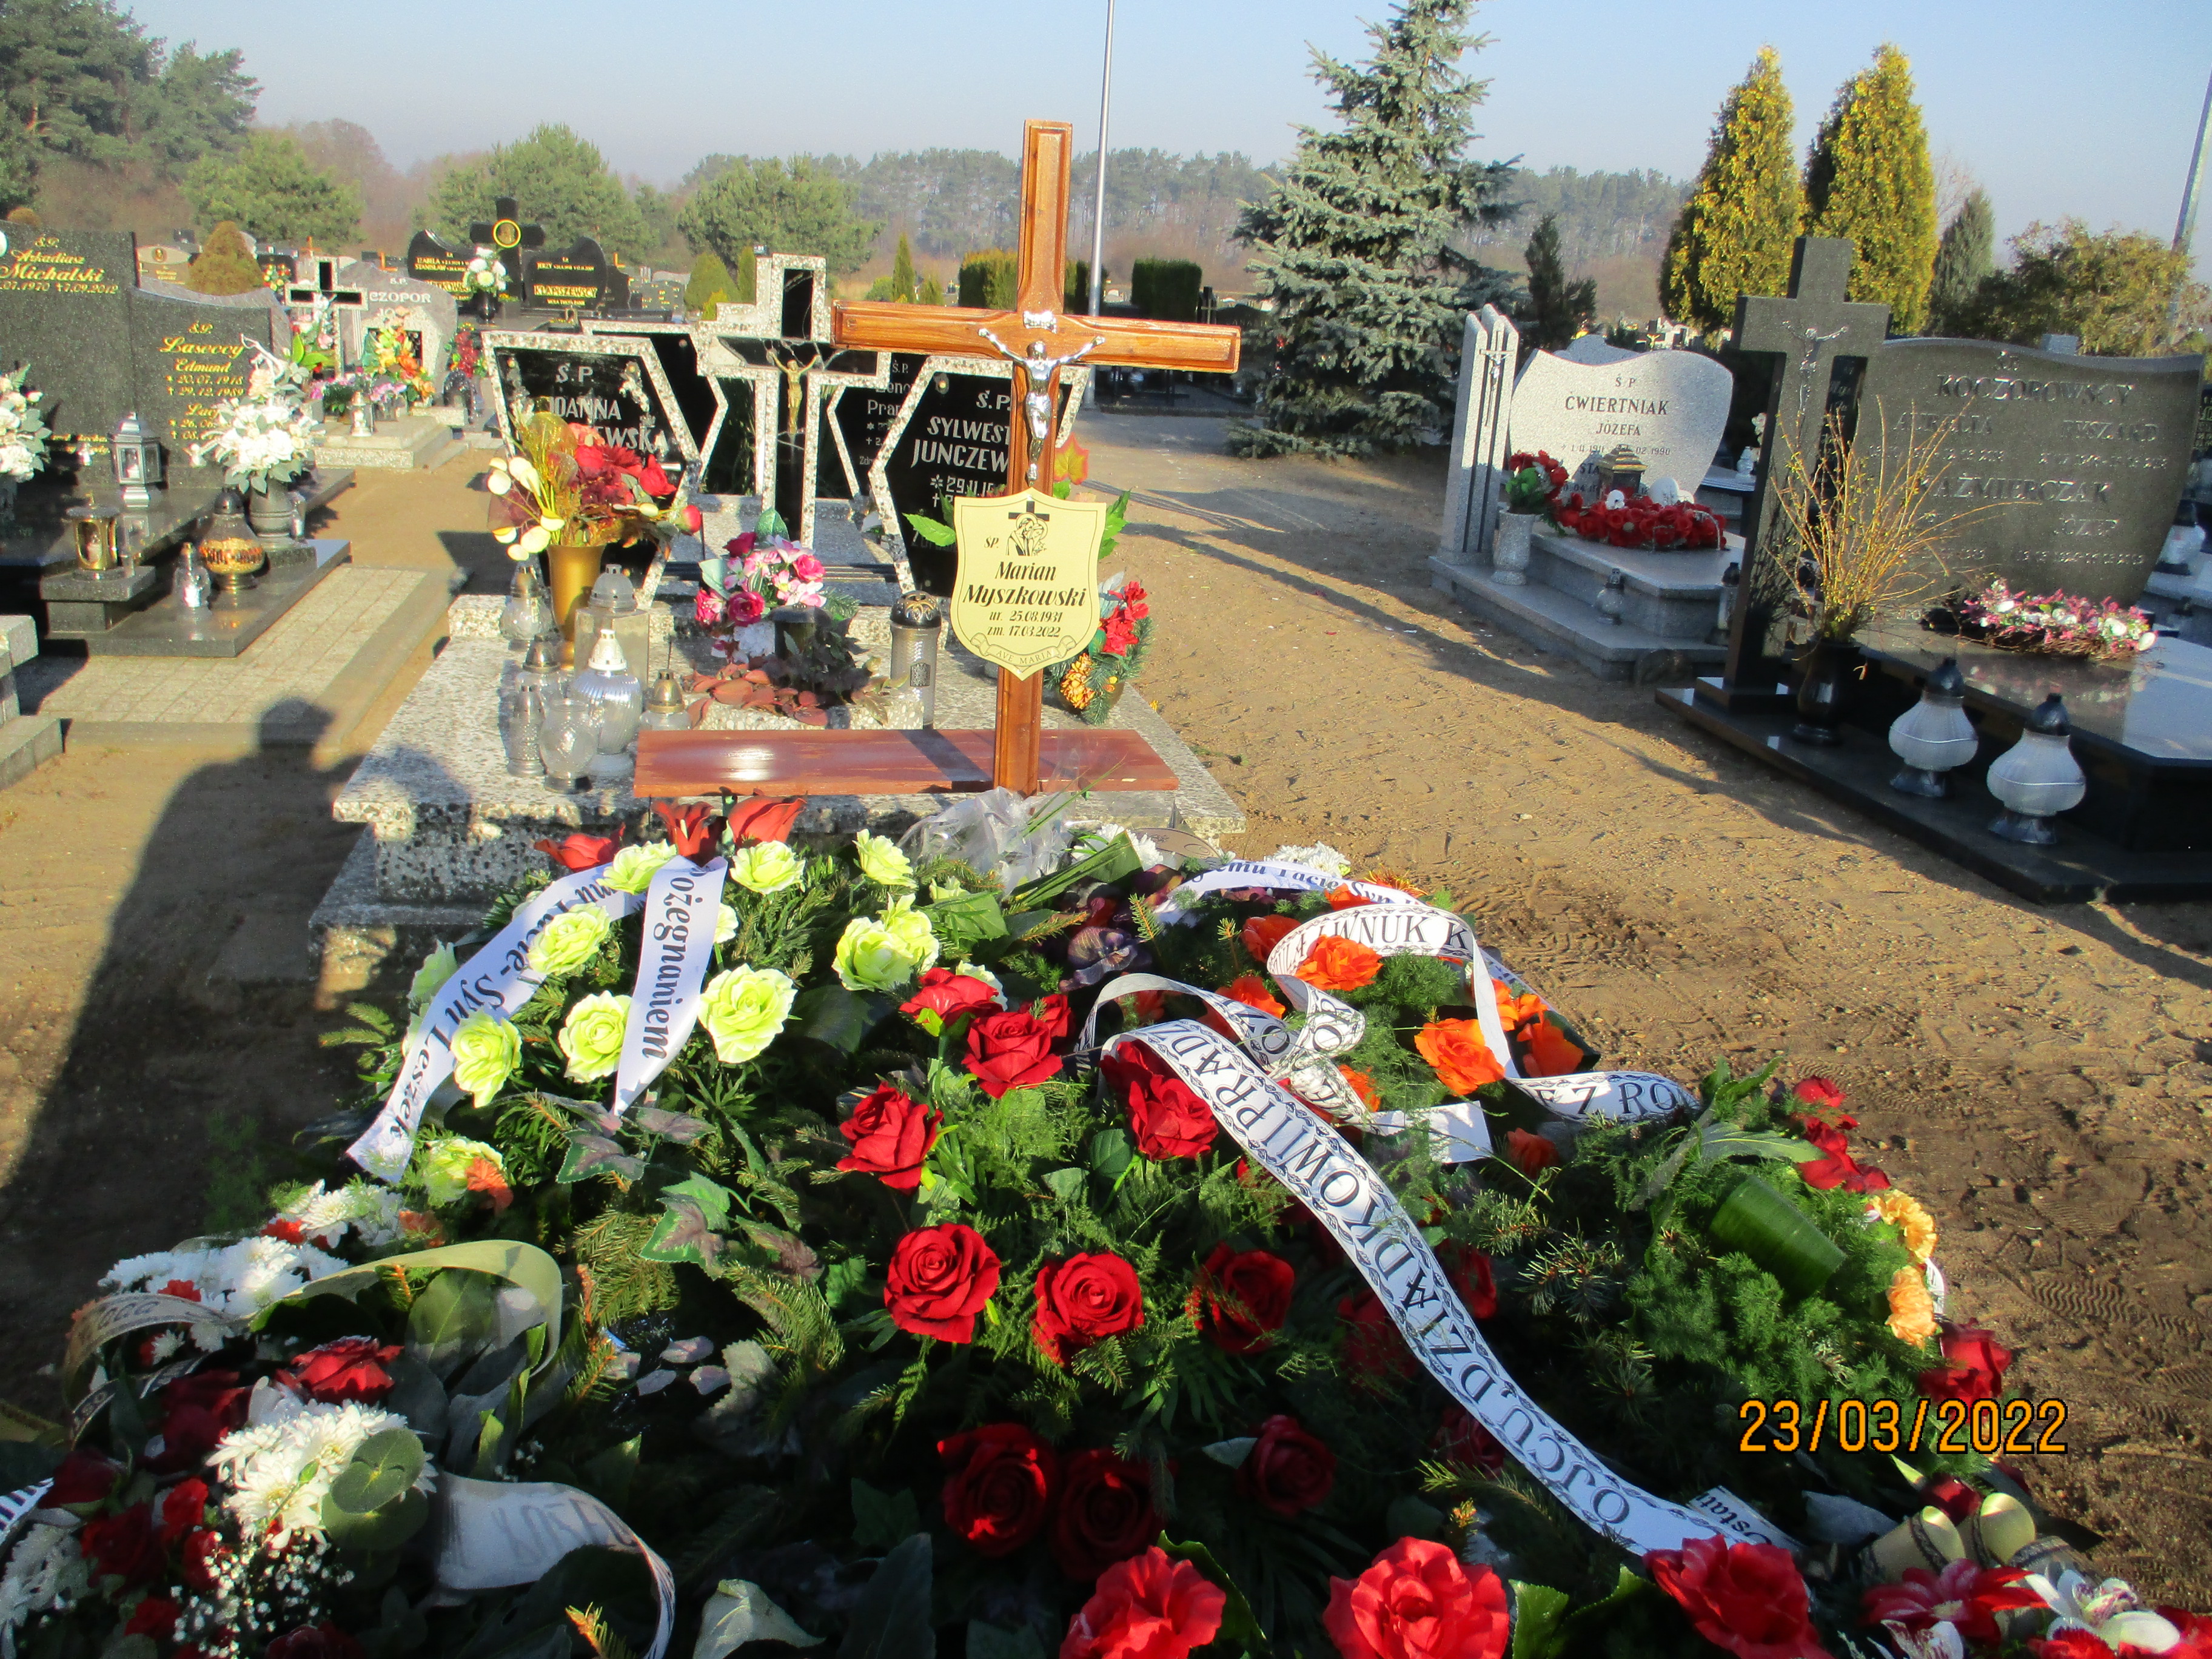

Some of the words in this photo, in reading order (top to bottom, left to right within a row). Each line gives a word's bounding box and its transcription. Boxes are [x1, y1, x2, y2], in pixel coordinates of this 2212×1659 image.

[0, 263, 105, 282] Michalski
[175, 358, 232, 373] Edmund
[994, 561, 1056, 581] Marian
[962, 584, 1087, 607] Myszkowski
[989, 612, 1003, 622] ur.
[1009, 610, 1063, 623] 25.08.1931
[987, 626, 1005, 636] zm.
[1009, 625, 1061, 637] 17.03.2022
[996, 650, 1014, 662] AVE
[1019, 650, 1052, 665] MARIA
